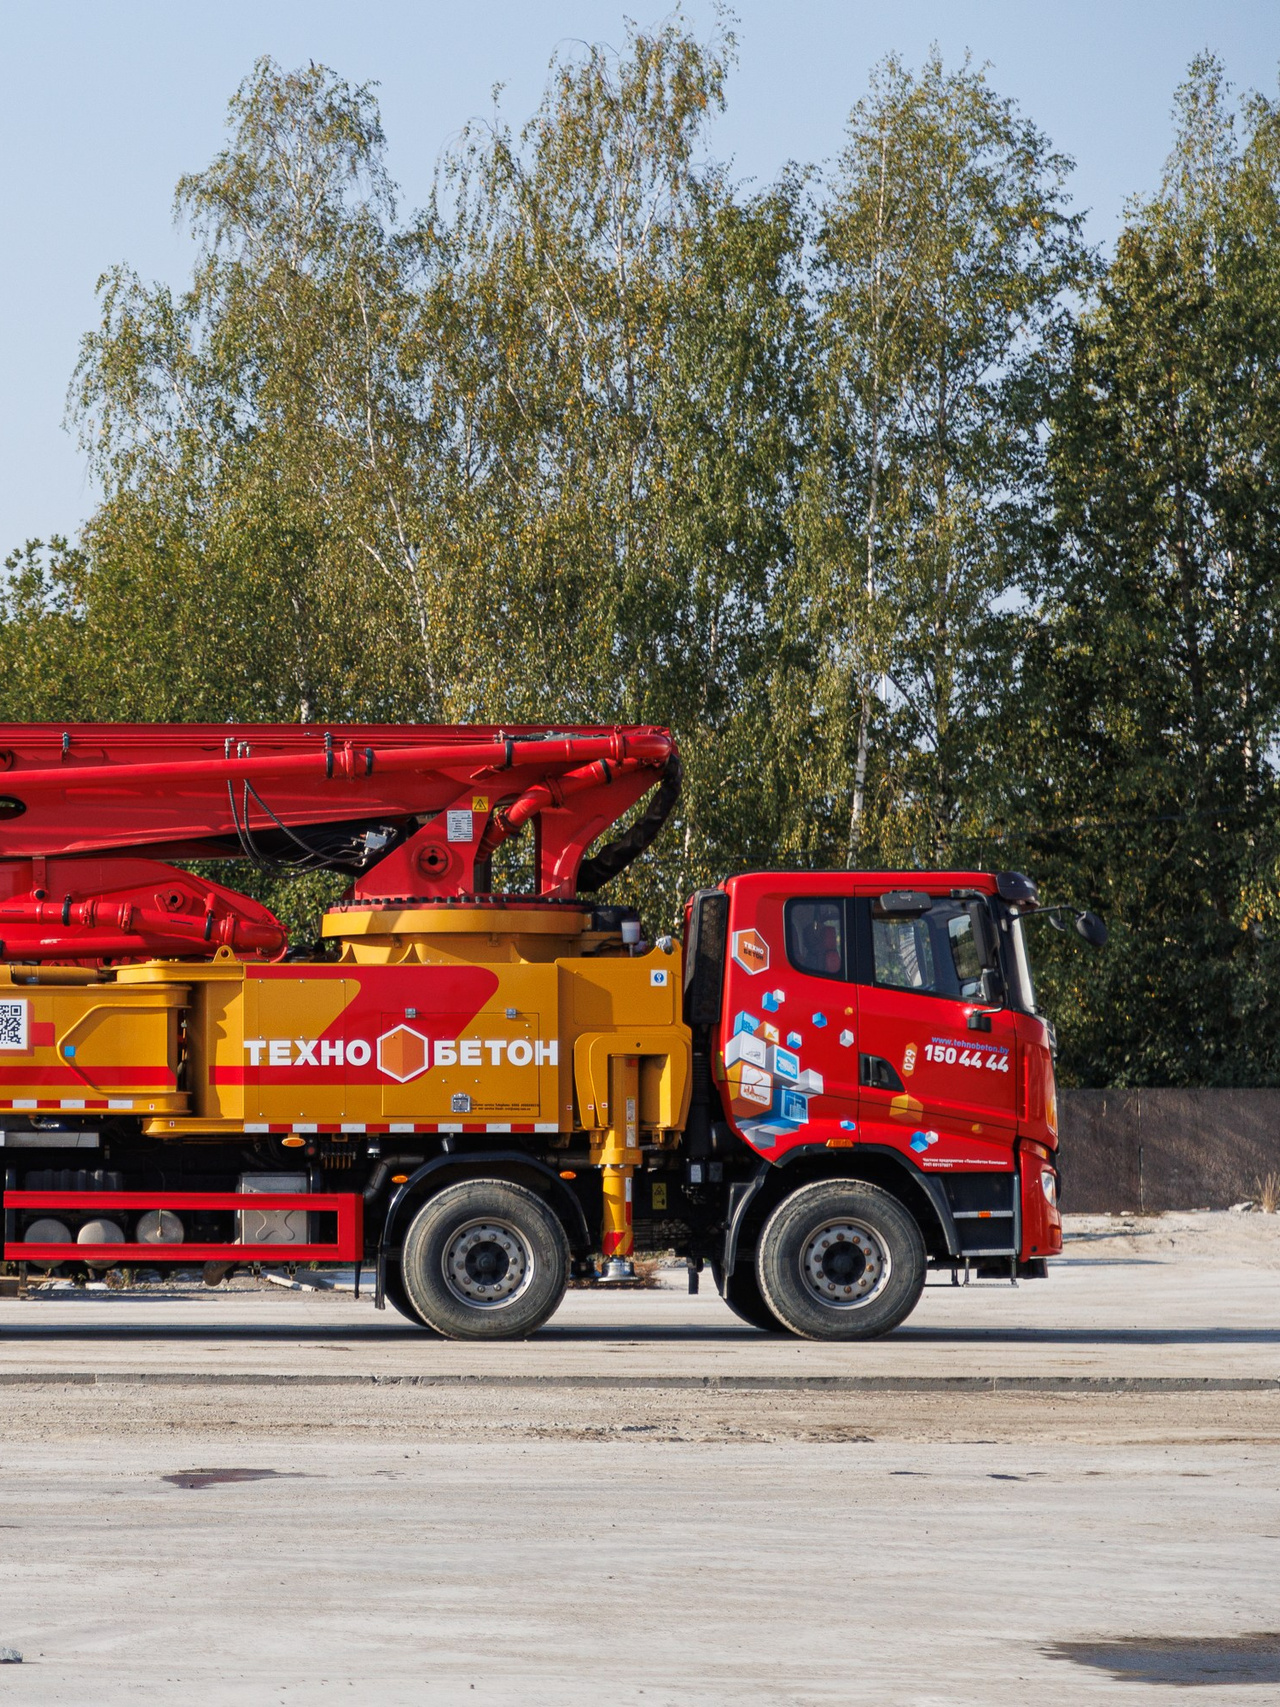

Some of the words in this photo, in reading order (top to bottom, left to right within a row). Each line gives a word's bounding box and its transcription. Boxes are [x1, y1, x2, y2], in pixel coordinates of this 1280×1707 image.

[743, 941, 764, 955] ТЕХНО
[743, 948, 764, 961] БЕТОН
[243, 1040, 371, 1066] ТЕХНО
[434, 1040, 559, 1066] БЕТОН
[931, 1036, 1010, 1055] www.tehnobeton.by
[903, 1049, 916, 1071] 029
[924, 1044, 957, 1064] 150
[958, 1050, 982, 1069] 44
[985, 1054, 1009, 1073] 44
